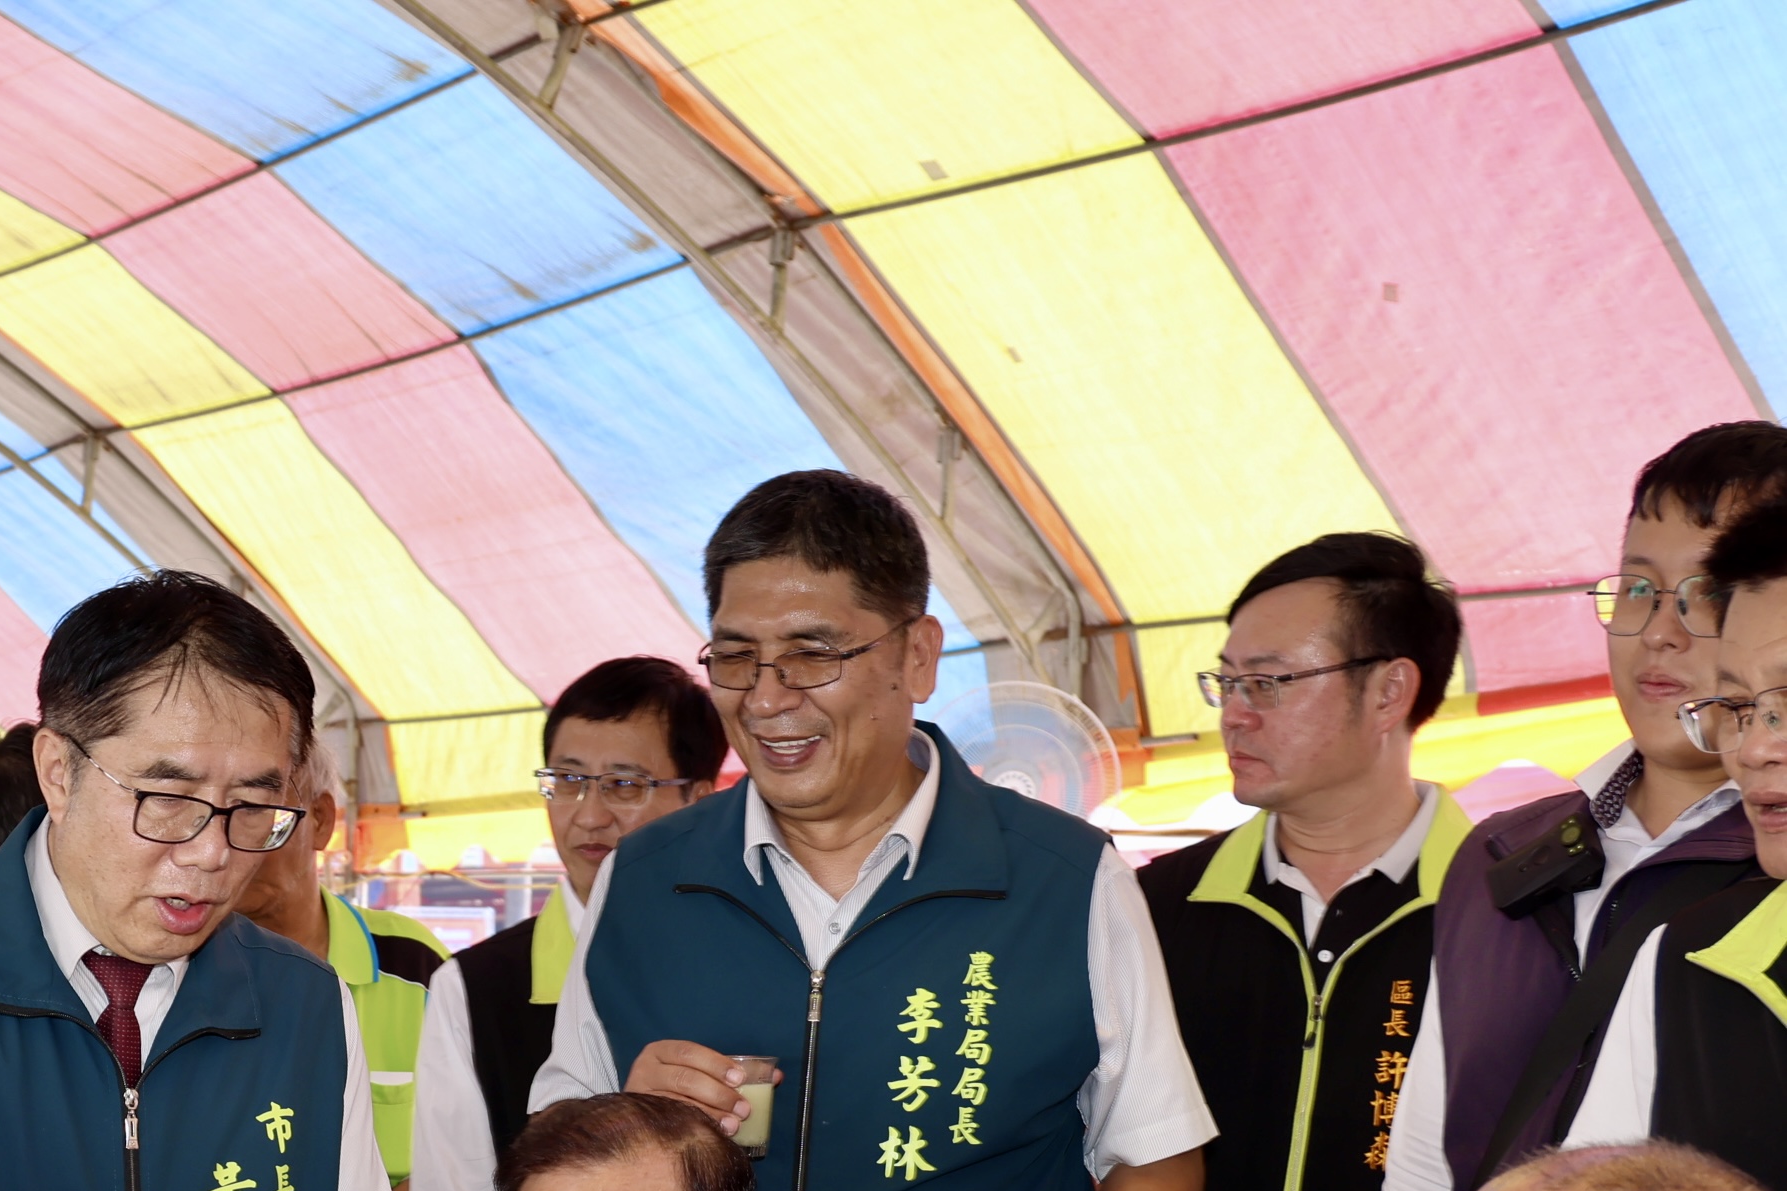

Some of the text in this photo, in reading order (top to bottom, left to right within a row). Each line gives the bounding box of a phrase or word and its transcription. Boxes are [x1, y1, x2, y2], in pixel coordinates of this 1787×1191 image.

[876, 988, 943, 1181] 李芳林
[948, 950, 999, 1145] 農業局局長
[1383, 980, 1414, 1037] 區長
